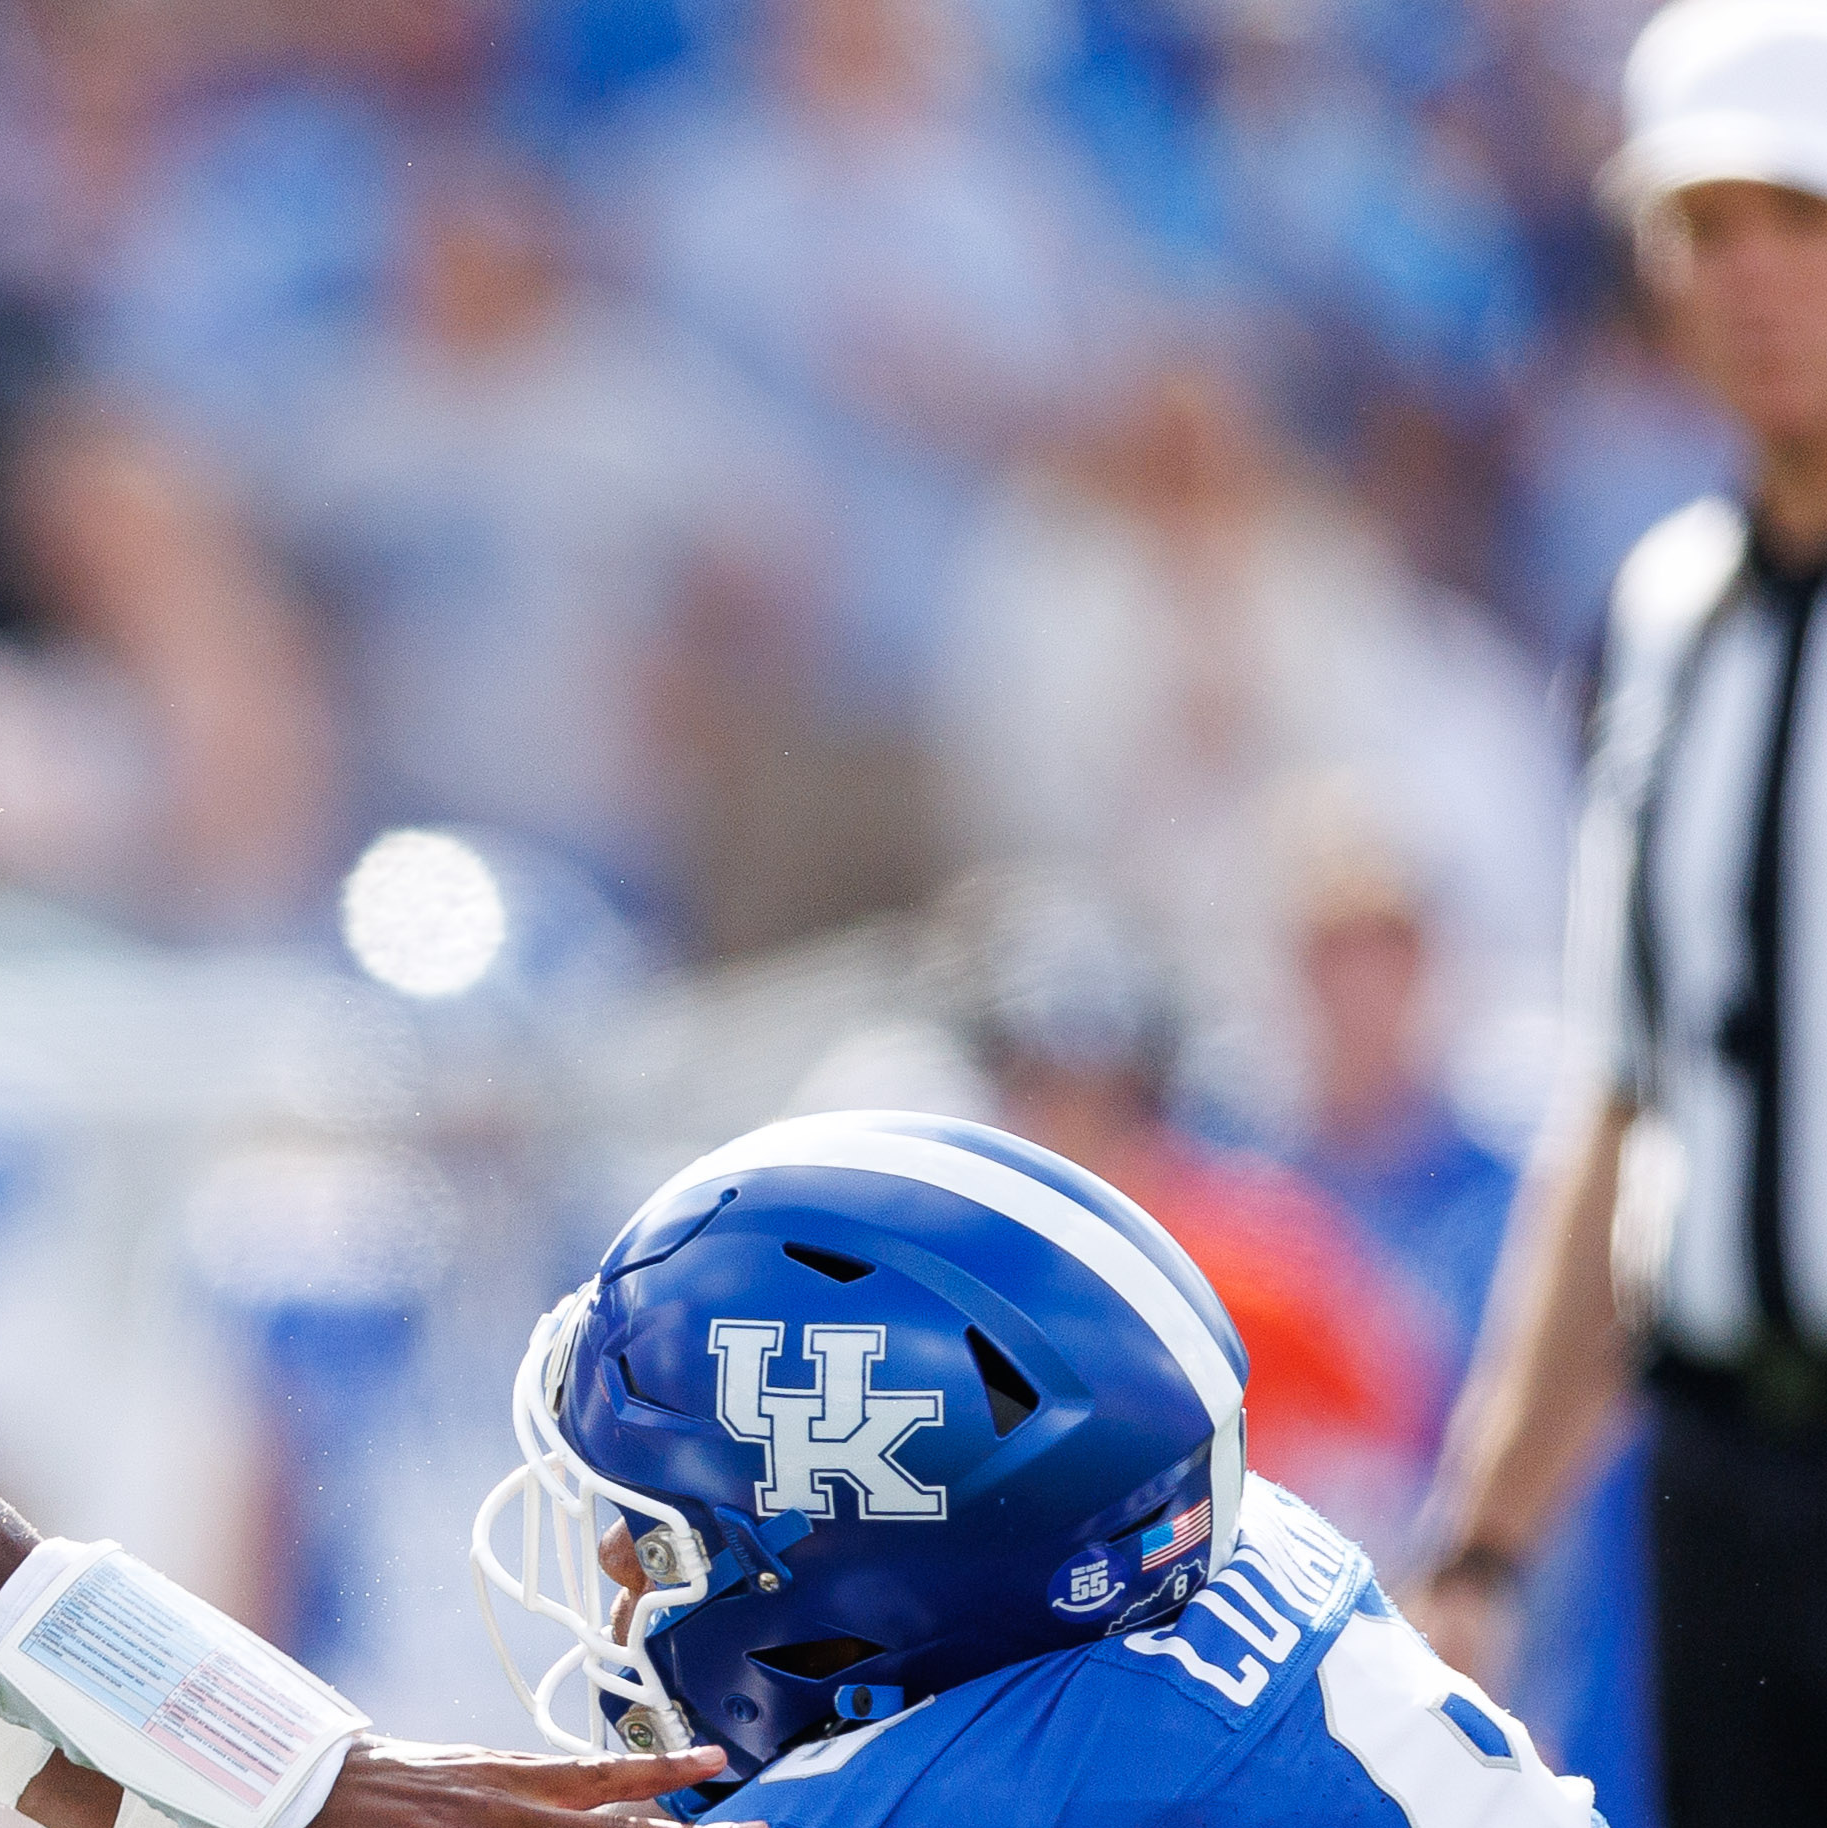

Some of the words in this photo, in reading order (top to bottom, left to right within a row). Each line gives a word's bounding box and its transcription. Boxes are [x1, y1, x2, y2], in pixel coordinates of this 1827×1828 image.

[707, 1318, 948, 1521] UK
[1071, 1569, 1108, 1602] 55
[1173, 1574, 1188, 1600] 8
